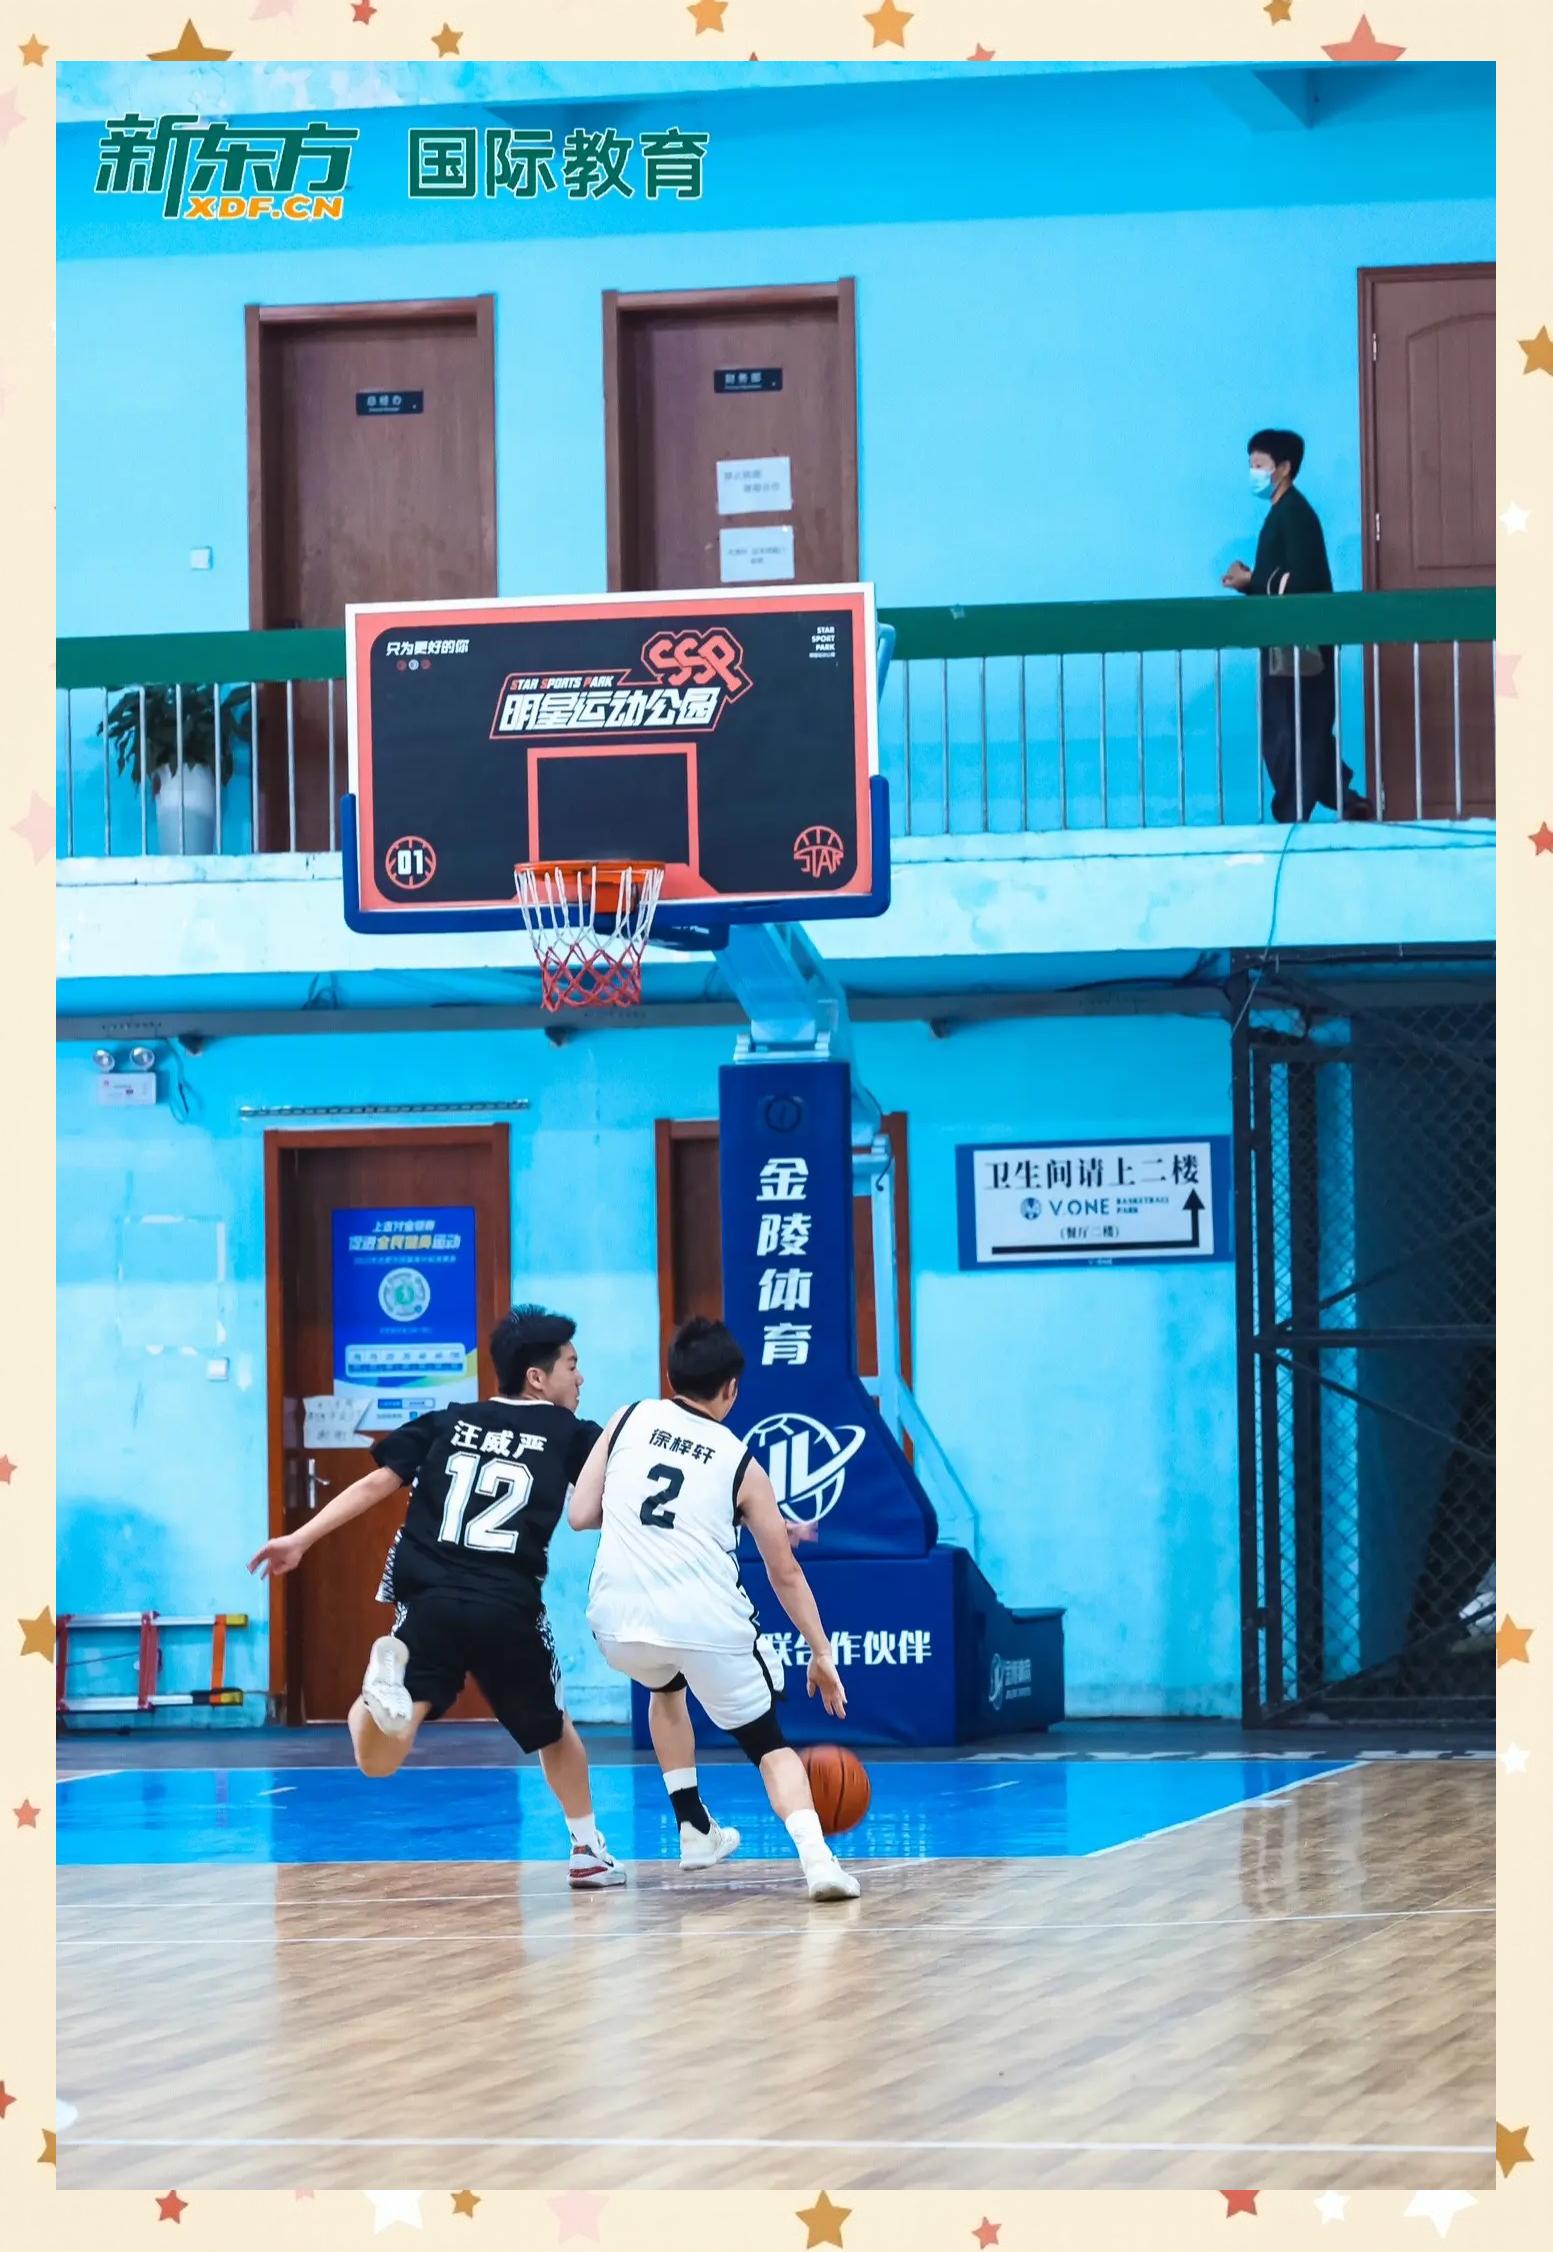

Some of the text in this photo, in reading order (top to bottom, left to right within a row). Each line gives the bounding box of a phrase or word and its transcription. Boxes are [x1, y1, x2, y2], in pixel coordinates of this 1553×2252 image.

[386, 639, 470, 656] 只为更好的你
[811, 635, 836, 643] SPORT
[817, 626, 835, 634] STAR
[649, 635, 742, 692] SSP
[510, 674, 615, 691] STAR SPORTS PARK
[499, 687, 721, 732] 明星运动公园
[397, 849, 424, 875] 01
[794, 846, 844, 878] STAR
[984, 1154, 1200, 1190] 卫生间请上二楼
[756, 1157, 813, 1366] 金陵体育
[450, 1420, 547, 1459] 汪威严
[649, 1428, 716, 1464] 徐梓轩
[438, 1450, 534, 1553] 12
[640, 1463, 685, 1529] 2
